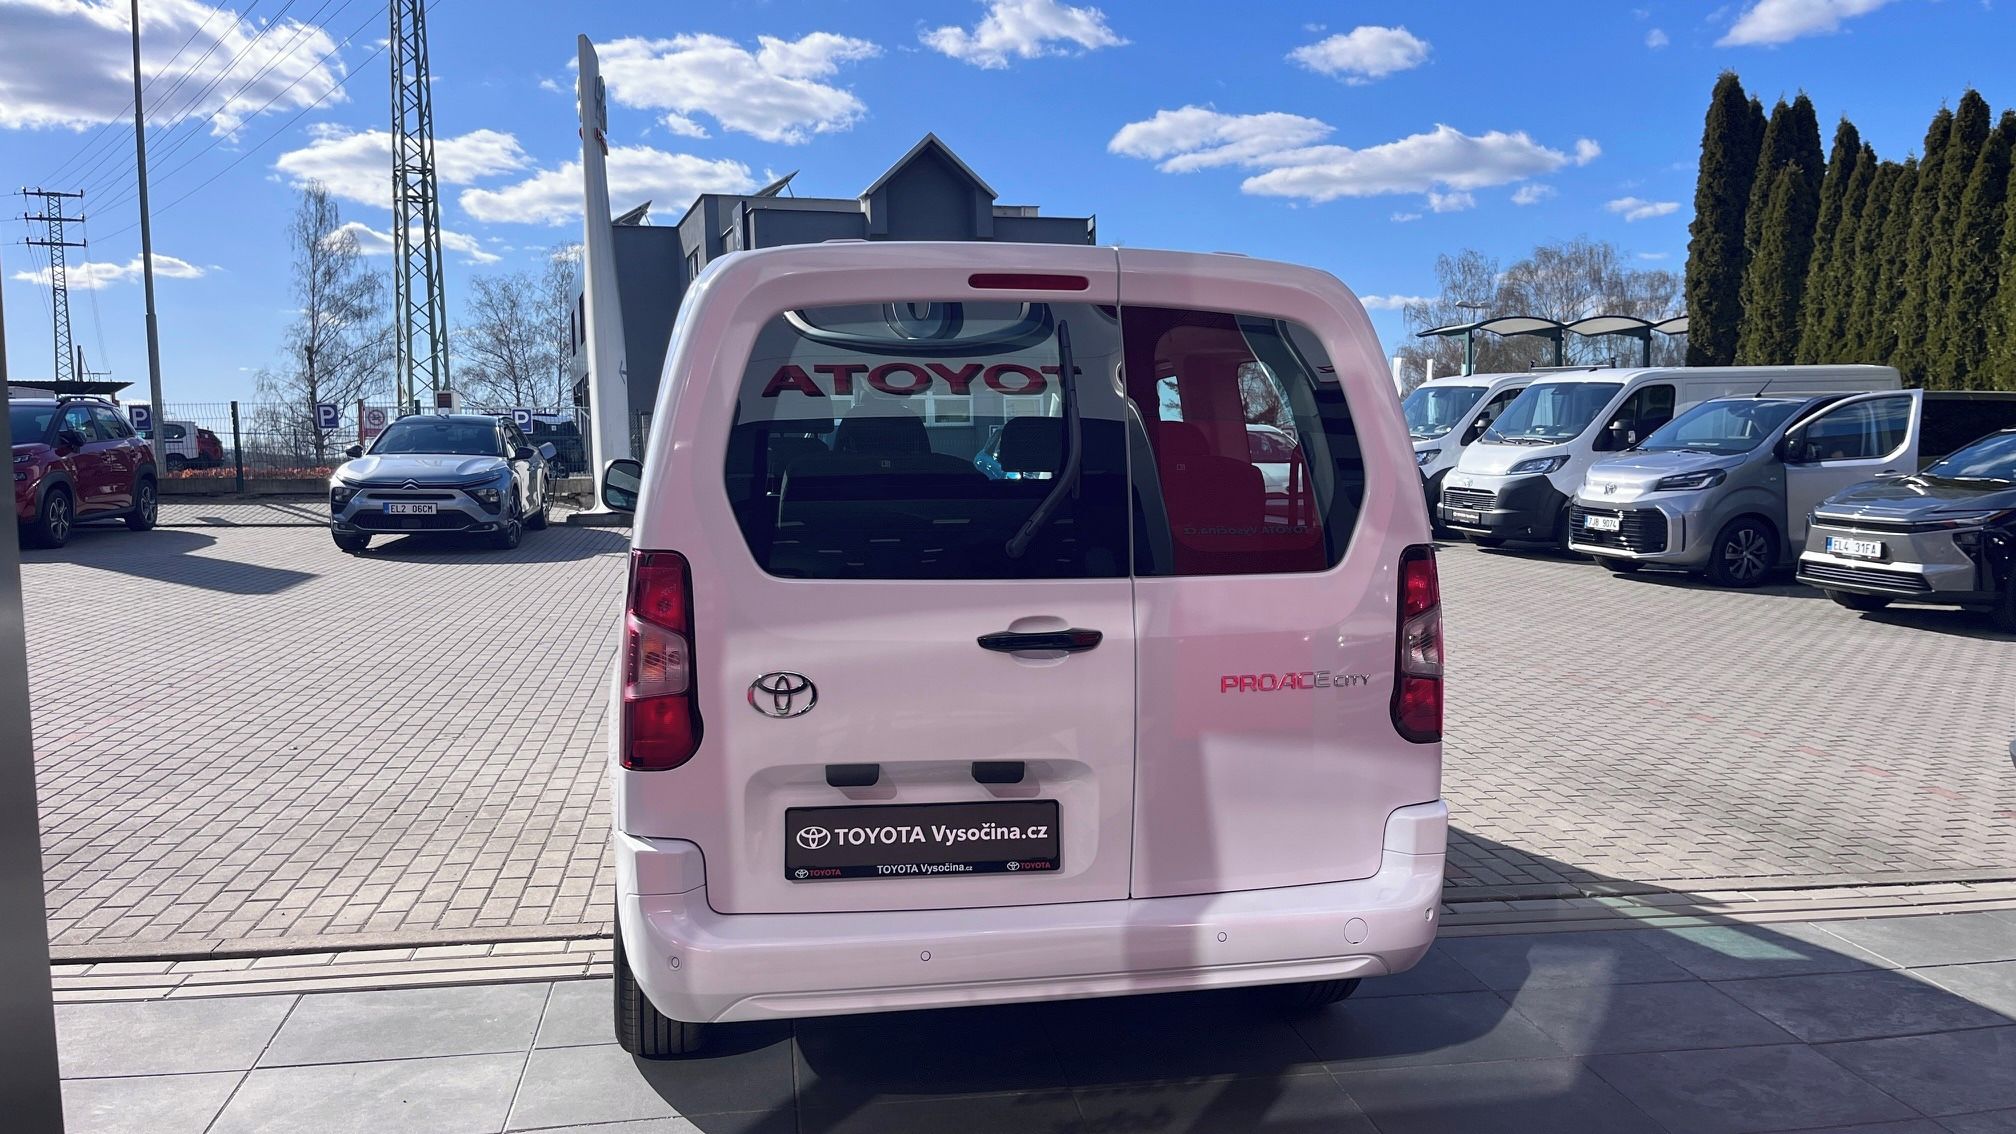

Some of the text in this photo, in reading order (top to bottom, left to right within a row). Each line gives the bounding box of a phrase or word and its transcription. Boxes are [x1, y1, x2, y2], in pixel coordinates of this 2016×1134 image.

[132, 408, 148, 428] P
[319, 406, 335, 427] P
[514, 411, 529, 424] P
[390, 504, 407, 513] EL2
[1834, 540, 1876, 554] EL4 31FA
[1220, 670, 1371, 693] PROACE CITY
[835, 822, 1048, 846] TOYOTA Vysočina.cz
[877, 862, 973, 875] TOYOTA Vysočina.cz
[1020, 861, 1051, 870] TOYOTA
[810, 868, 842, 877] TOYOTA
